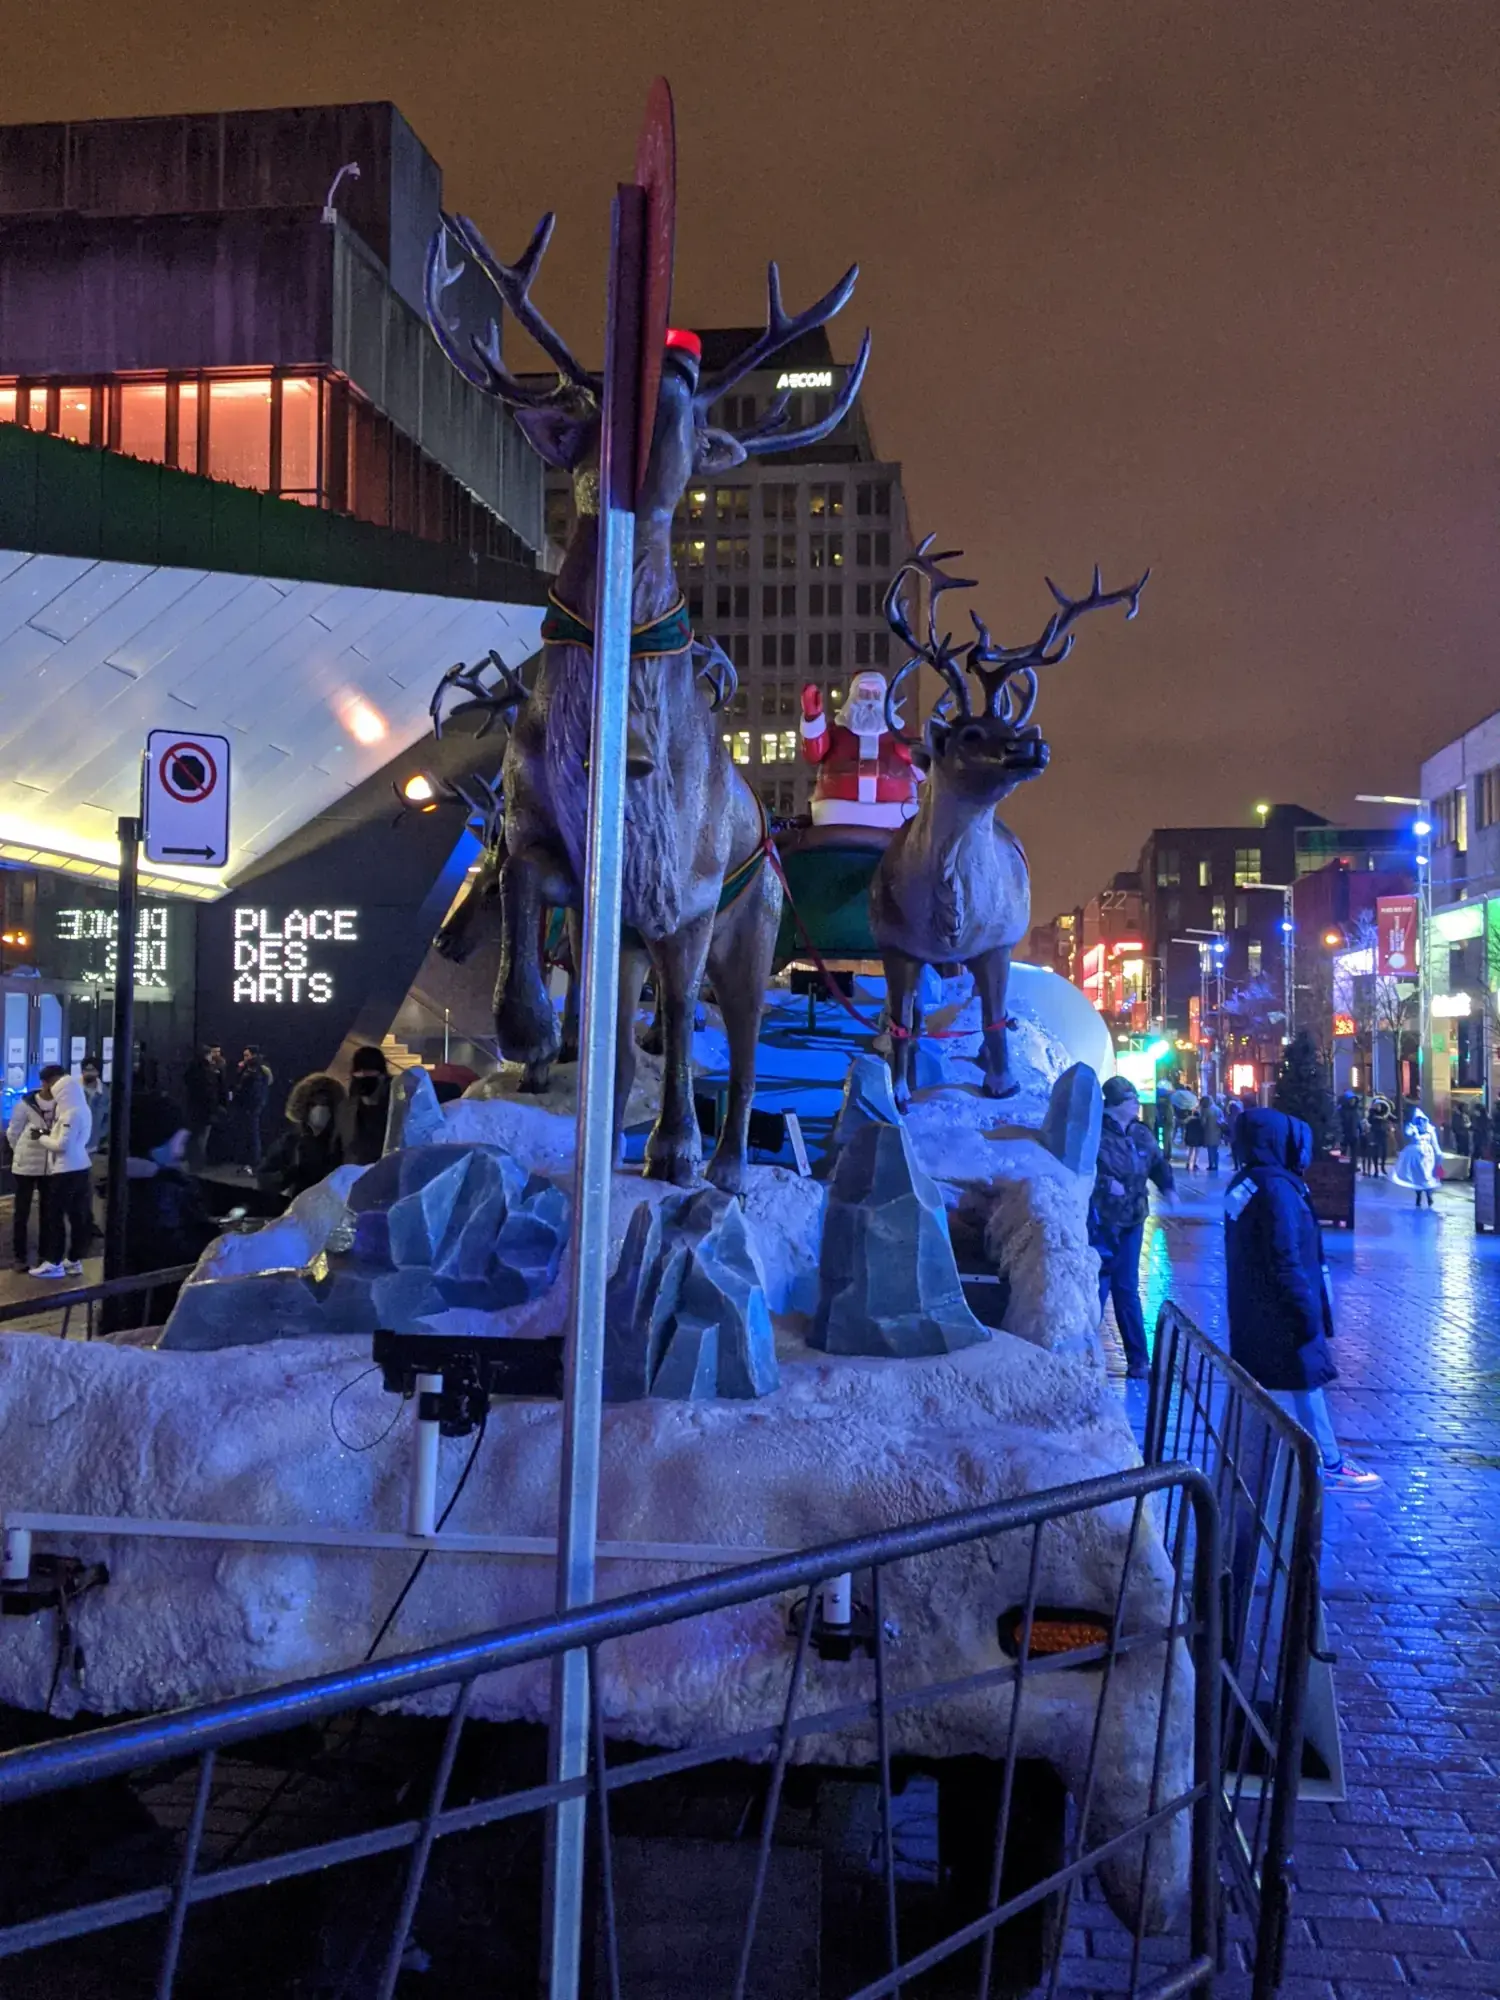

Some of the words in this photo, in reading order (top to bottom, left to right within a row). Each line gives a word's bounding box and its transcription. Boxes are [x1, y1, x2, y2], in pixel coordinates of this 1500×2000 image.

[776, 371, 832, 389] AECOM
[233, 908, 358, 940] PLACE
[233, 941, 308, 971] DES
[233, 973, 333, 1003] ARTS
